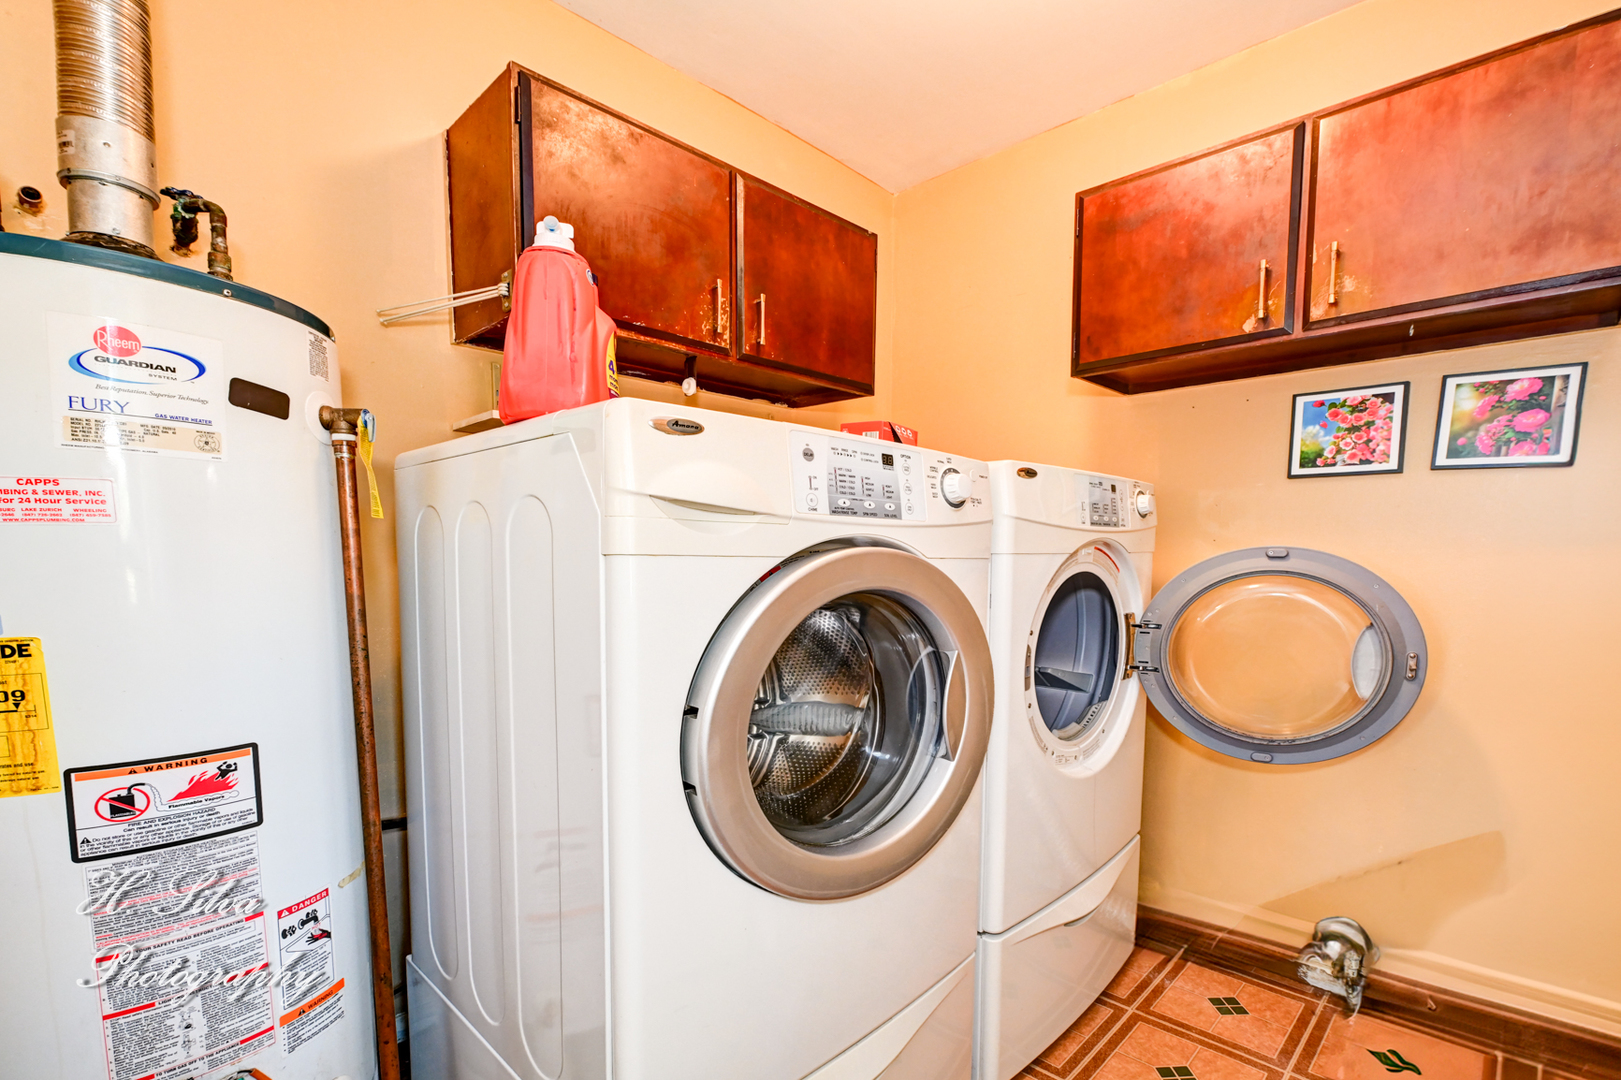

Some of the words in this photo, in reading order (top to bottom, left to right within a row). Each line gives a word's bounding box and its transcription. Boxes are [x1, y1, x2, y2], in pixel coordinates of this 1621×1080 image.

[97, 330, 140, 351] Rheem
[94, 356, 176, 373] GUARDIAN
[68, 396, 130, 413] FURY
[149, 390, 176, 399] Superior
[178, 394, 209, 405] Technology
[672, 420, 699, 430] Amana
[16, 478, 60, 486] CAPPS
[144, 757, 208, 772] WARNING
[168, 800, 203, 809] Flammable
[158, 813, 191, 822] EXPLOSION
[292, 891, 328, 912] DANGER
[153, 941, 175, 949] SAFETY
[193, 929, 214, 938] BEFORE
[216, 919, 244, 931] OPERATING
[308, 990, 334, 1009] WARNING
[215, 1043, 239, 1054] APPLIANCE
